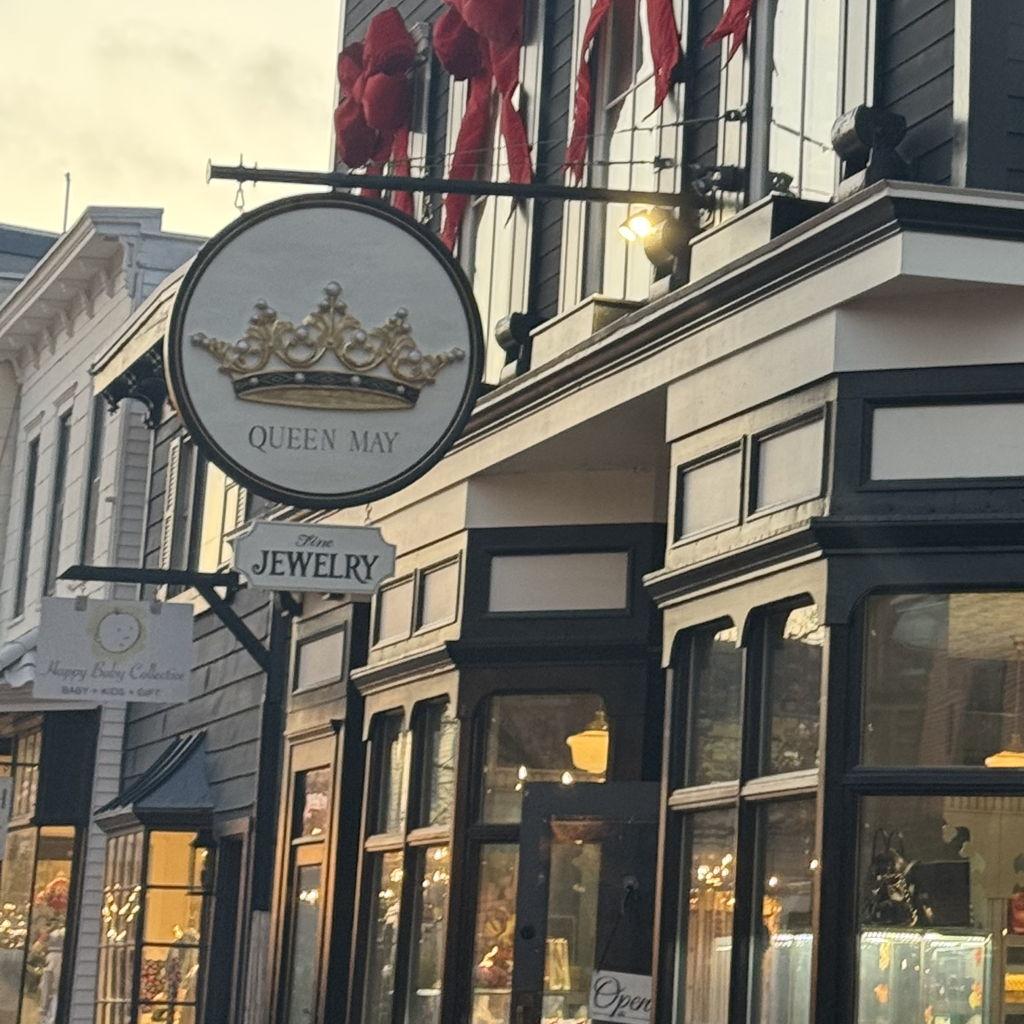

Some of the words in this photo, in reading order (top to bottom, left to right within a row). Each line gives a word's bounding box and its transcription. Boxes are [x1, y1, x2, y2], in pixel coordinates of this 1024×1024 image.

[248, 424, 337, 454] QUEEN
[349, 430, 400, 454] MAY
[295, 533, 335, 548] Fine
[252, 549, 380, 584] JEWELRY
[40, 659, 88, 682] Happy
[91, 660, 126, 682] Baby
[593, 976, 653, 1018] Open
